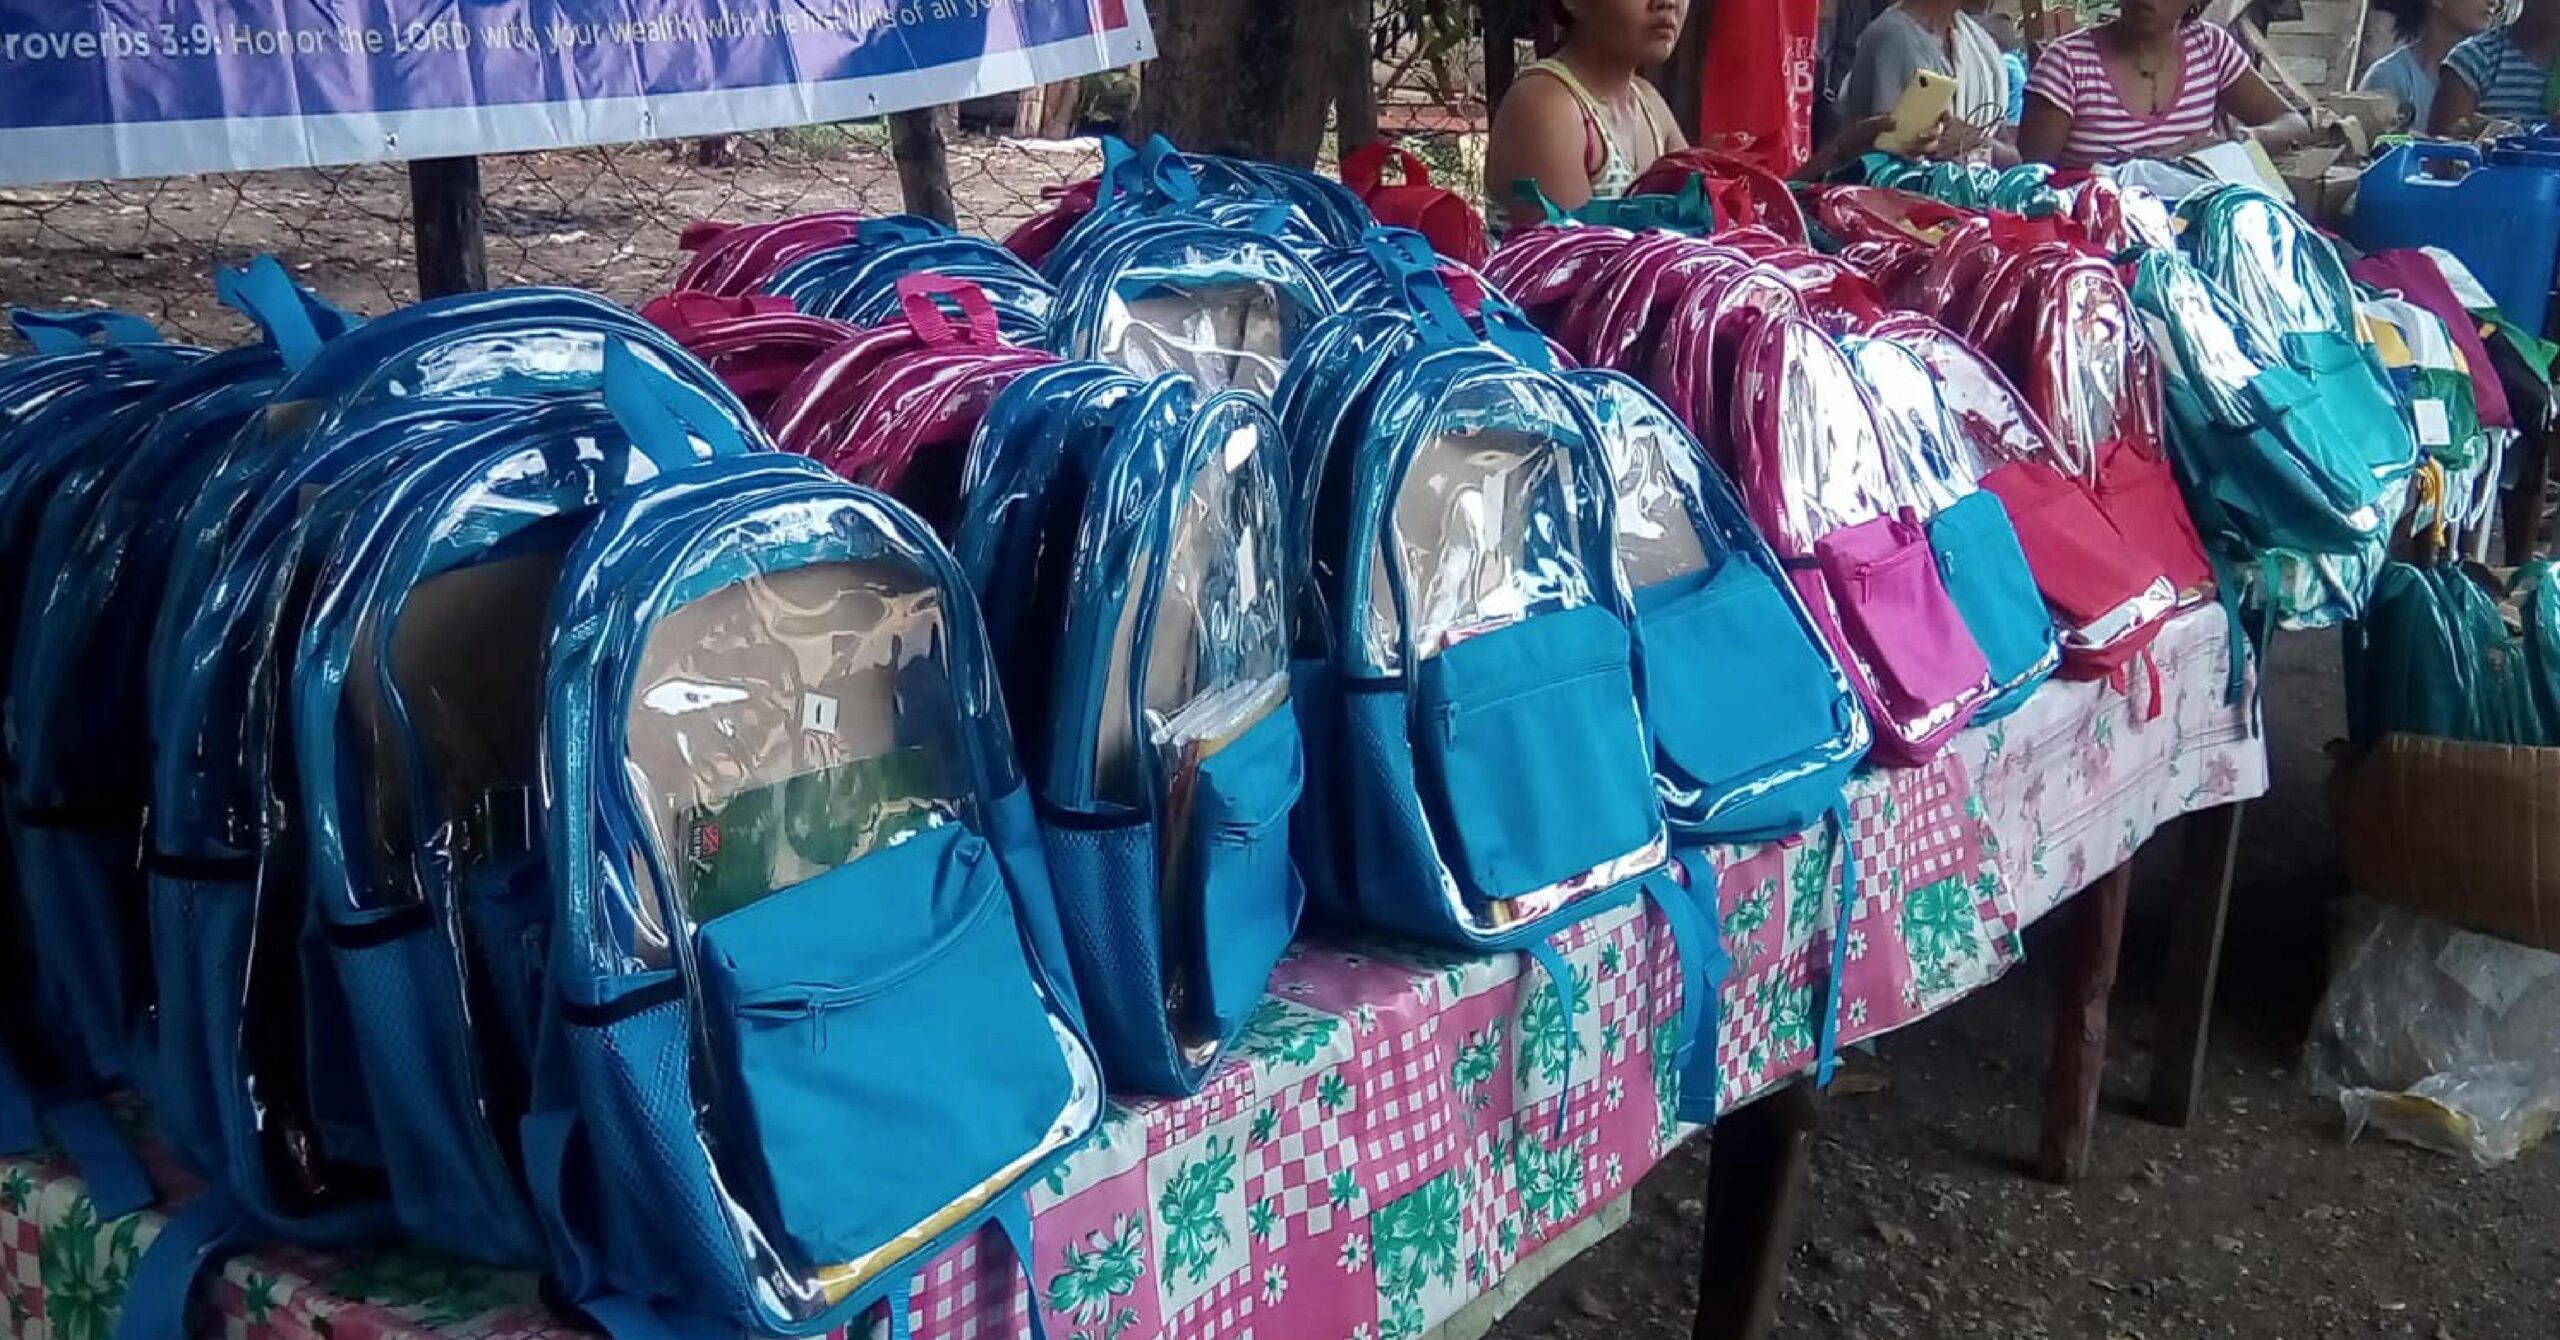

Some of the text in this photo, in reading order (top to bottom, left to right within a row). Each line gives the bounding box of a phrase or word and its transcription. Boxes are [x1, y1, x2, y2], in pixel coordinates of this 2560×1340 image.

[0, 22, 151, 60] roverbs
[229, 23, 327, 55] Honor
[392, 21, 471, 54] LORD
[480, 20, 541, 51] with
[545, 22, 601, 54] your
[901, 0, 926, 26] of
[932, 0, 961, 20] all
